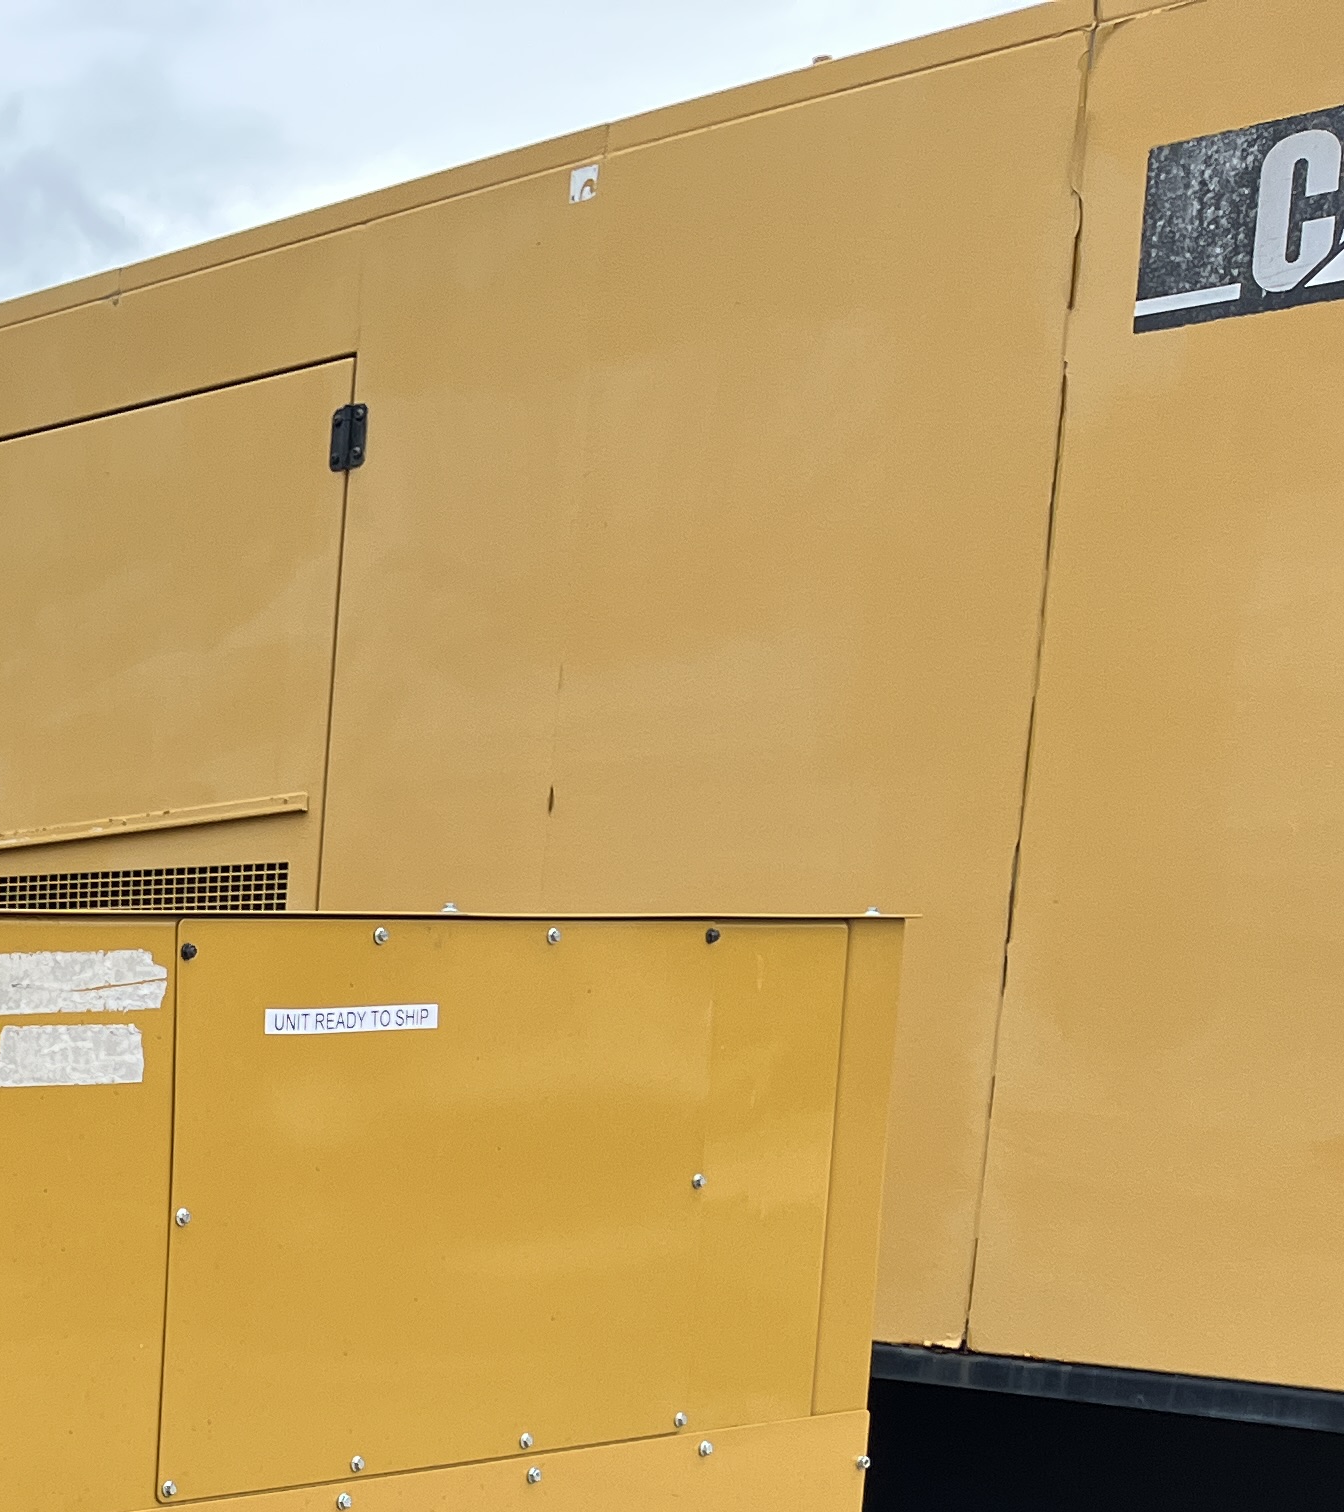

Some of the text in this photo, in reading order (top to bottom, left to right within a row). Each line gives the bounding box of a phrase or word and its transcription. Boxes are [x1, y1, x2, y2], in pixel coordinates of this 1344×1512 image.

[1252, 129, 1344, 293] C
[274, 1008, 429, 1031] UNIT READY TO SHIP
